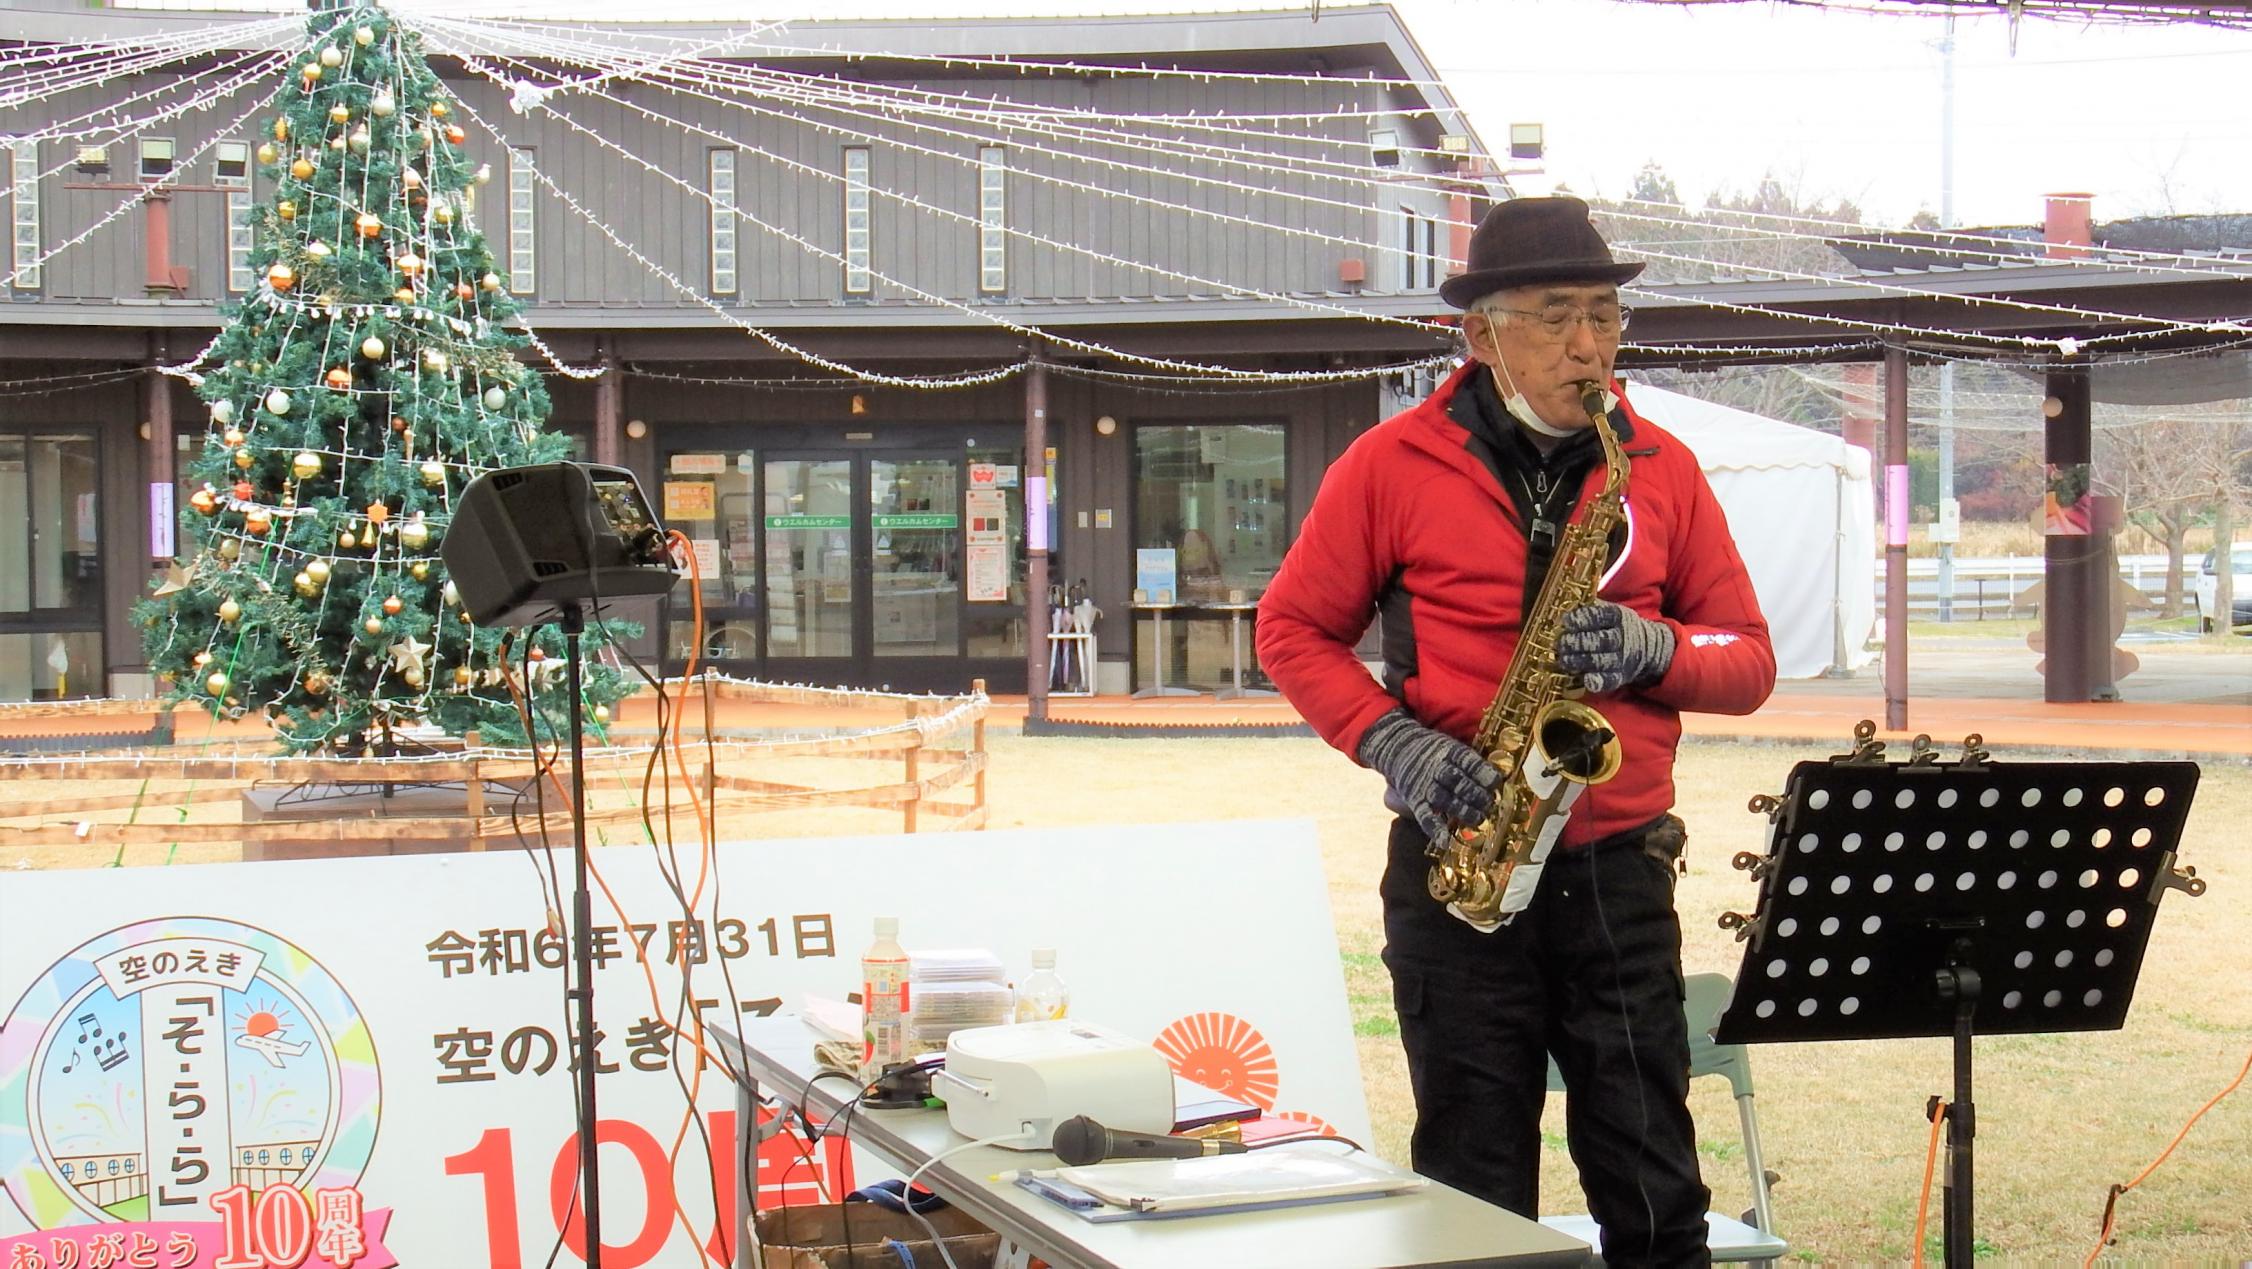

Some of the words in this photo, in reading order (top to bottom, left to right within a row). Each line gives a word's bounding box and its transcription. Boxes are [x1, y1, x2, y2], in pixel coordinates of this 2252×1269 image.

[119, 949, 242, 984] 空のえき
[9, 1231, 199, 1269] ありがとう
